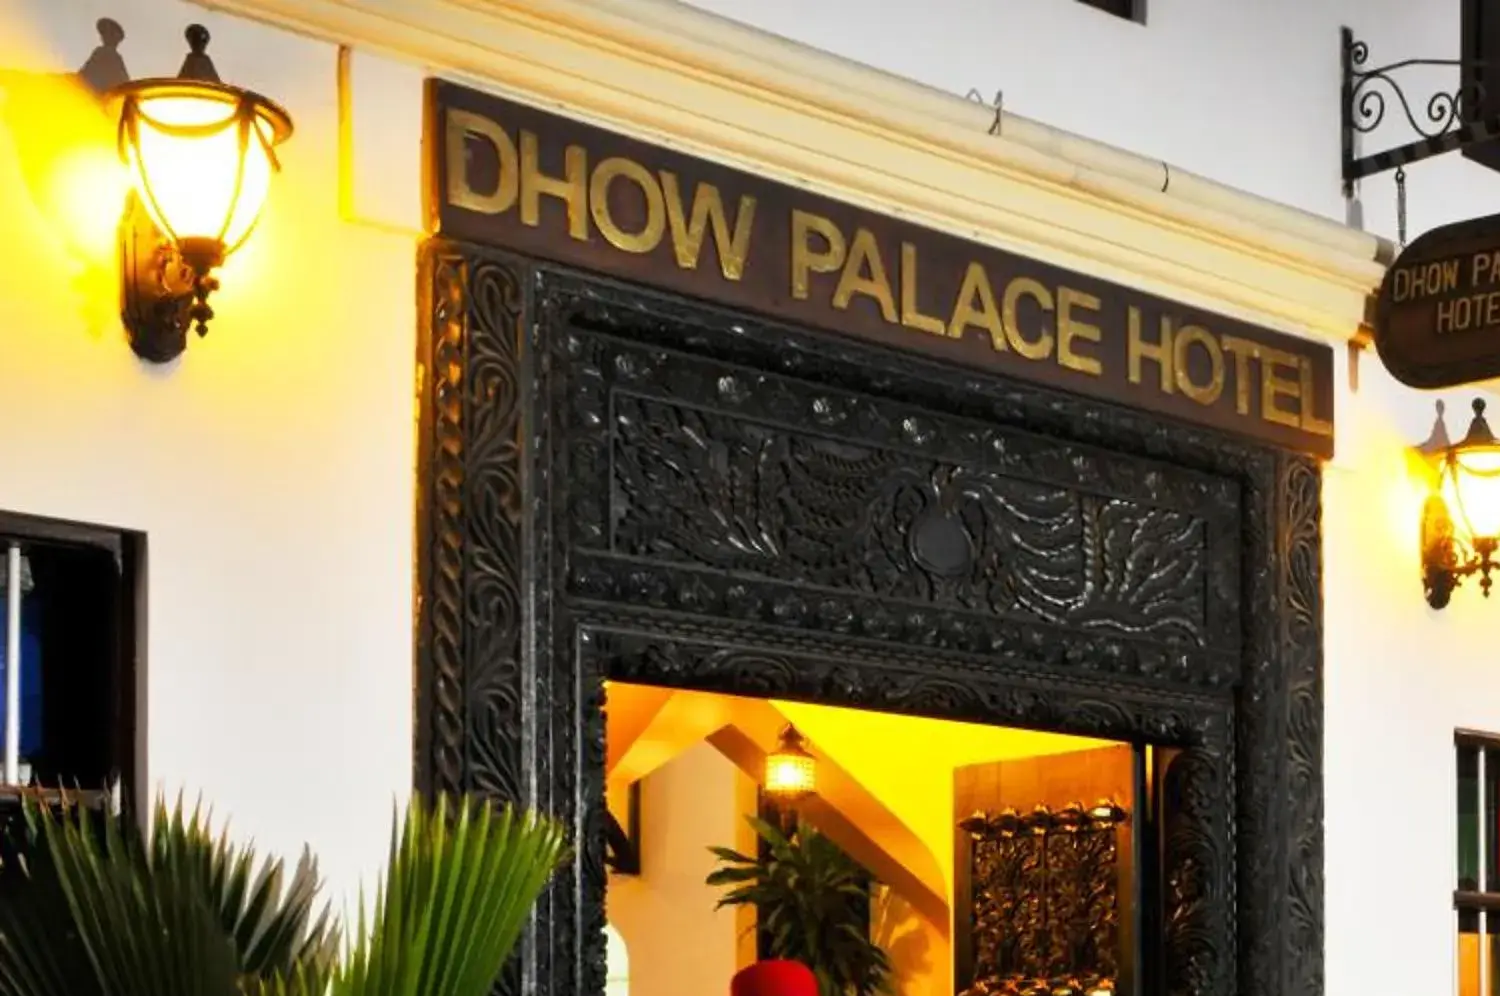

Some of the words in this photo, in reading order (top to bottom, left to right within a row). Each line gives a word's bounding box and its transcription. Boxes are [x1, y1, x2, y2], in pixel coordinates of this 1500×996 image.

[446, 107, 757, 281] DHOW
[792, 208, 1103, 375] PALACE
[1128, 305, 1334, 436] HOTEL
[1393, 258, 1460, 302] DHOW
